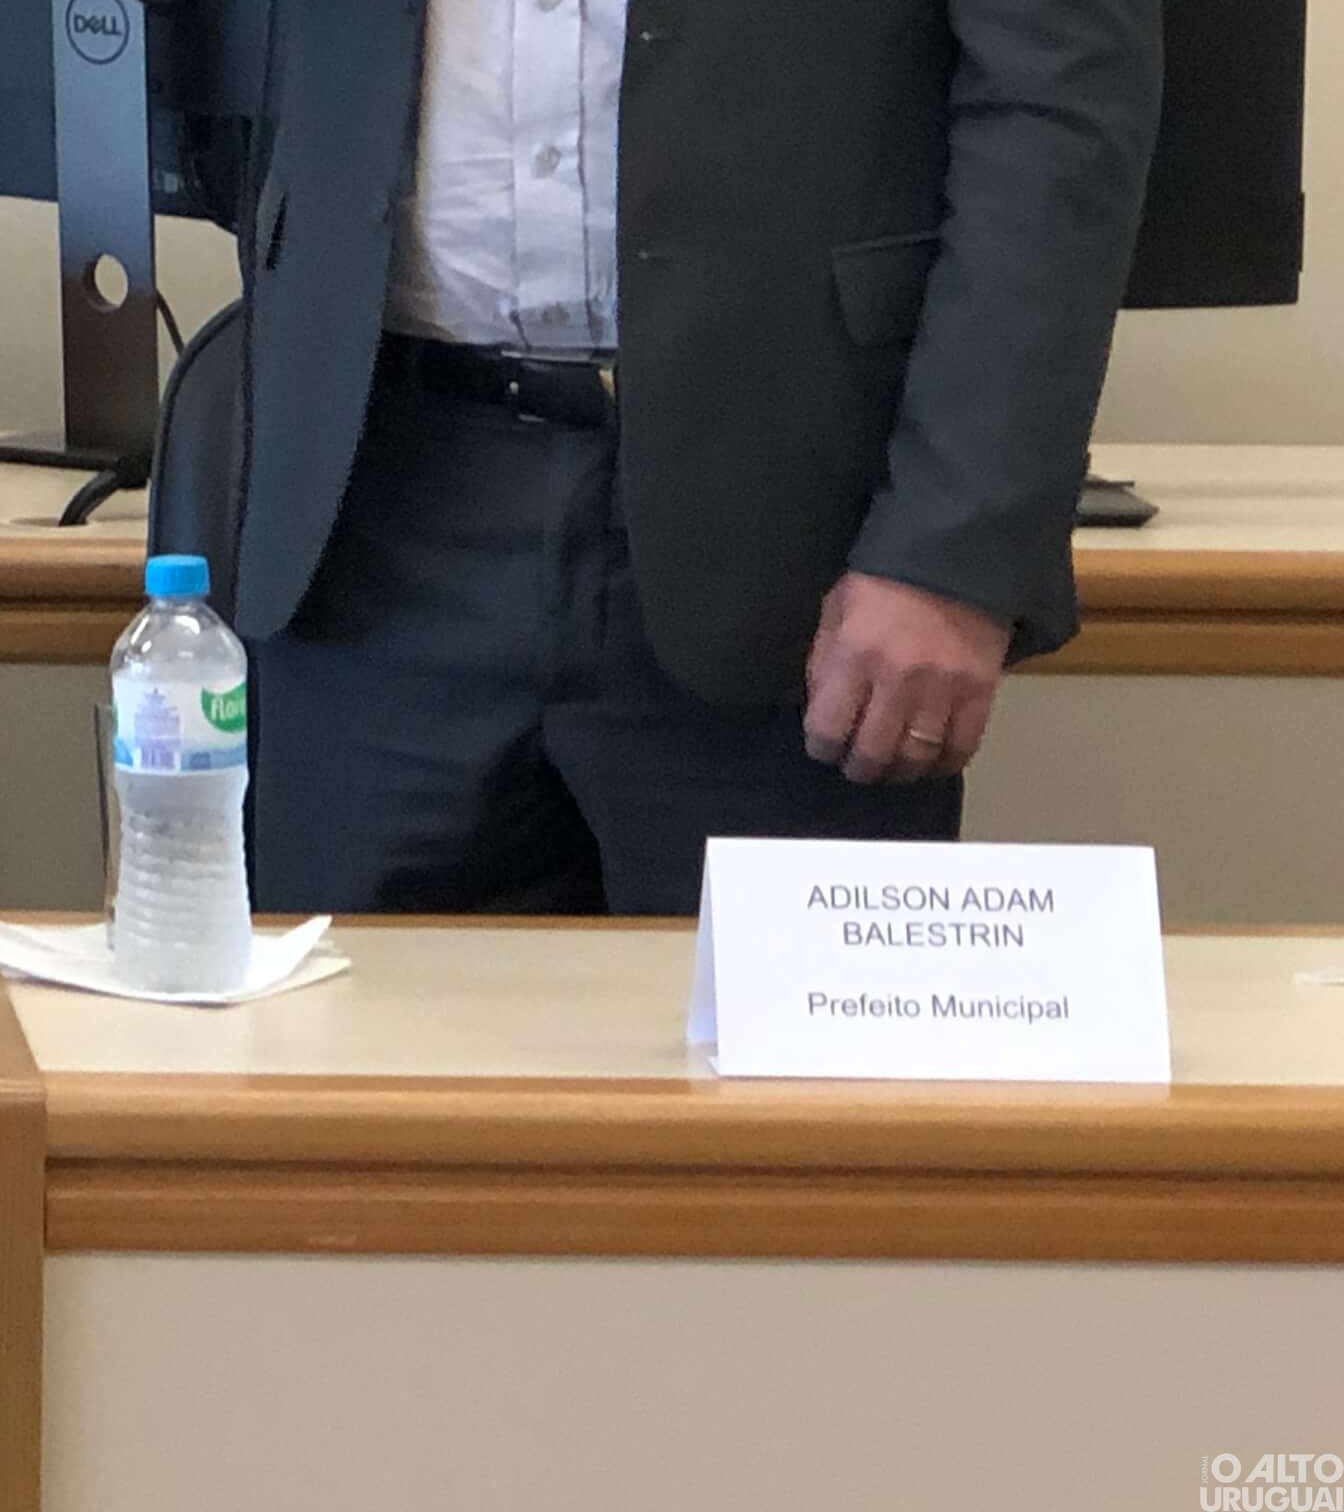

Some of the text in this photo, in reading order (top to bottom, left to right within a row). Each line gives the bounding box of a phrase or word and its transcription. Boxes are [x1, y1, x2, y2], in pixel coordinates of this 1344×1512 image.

[73, 14, 122, 35] DELL
[807, 884, 1055, 913] ADILSON ADAM
[843, 920, 1025, 948] BALESTRIN
[808, 991, 1069, 1025] Prefeito Municipal
